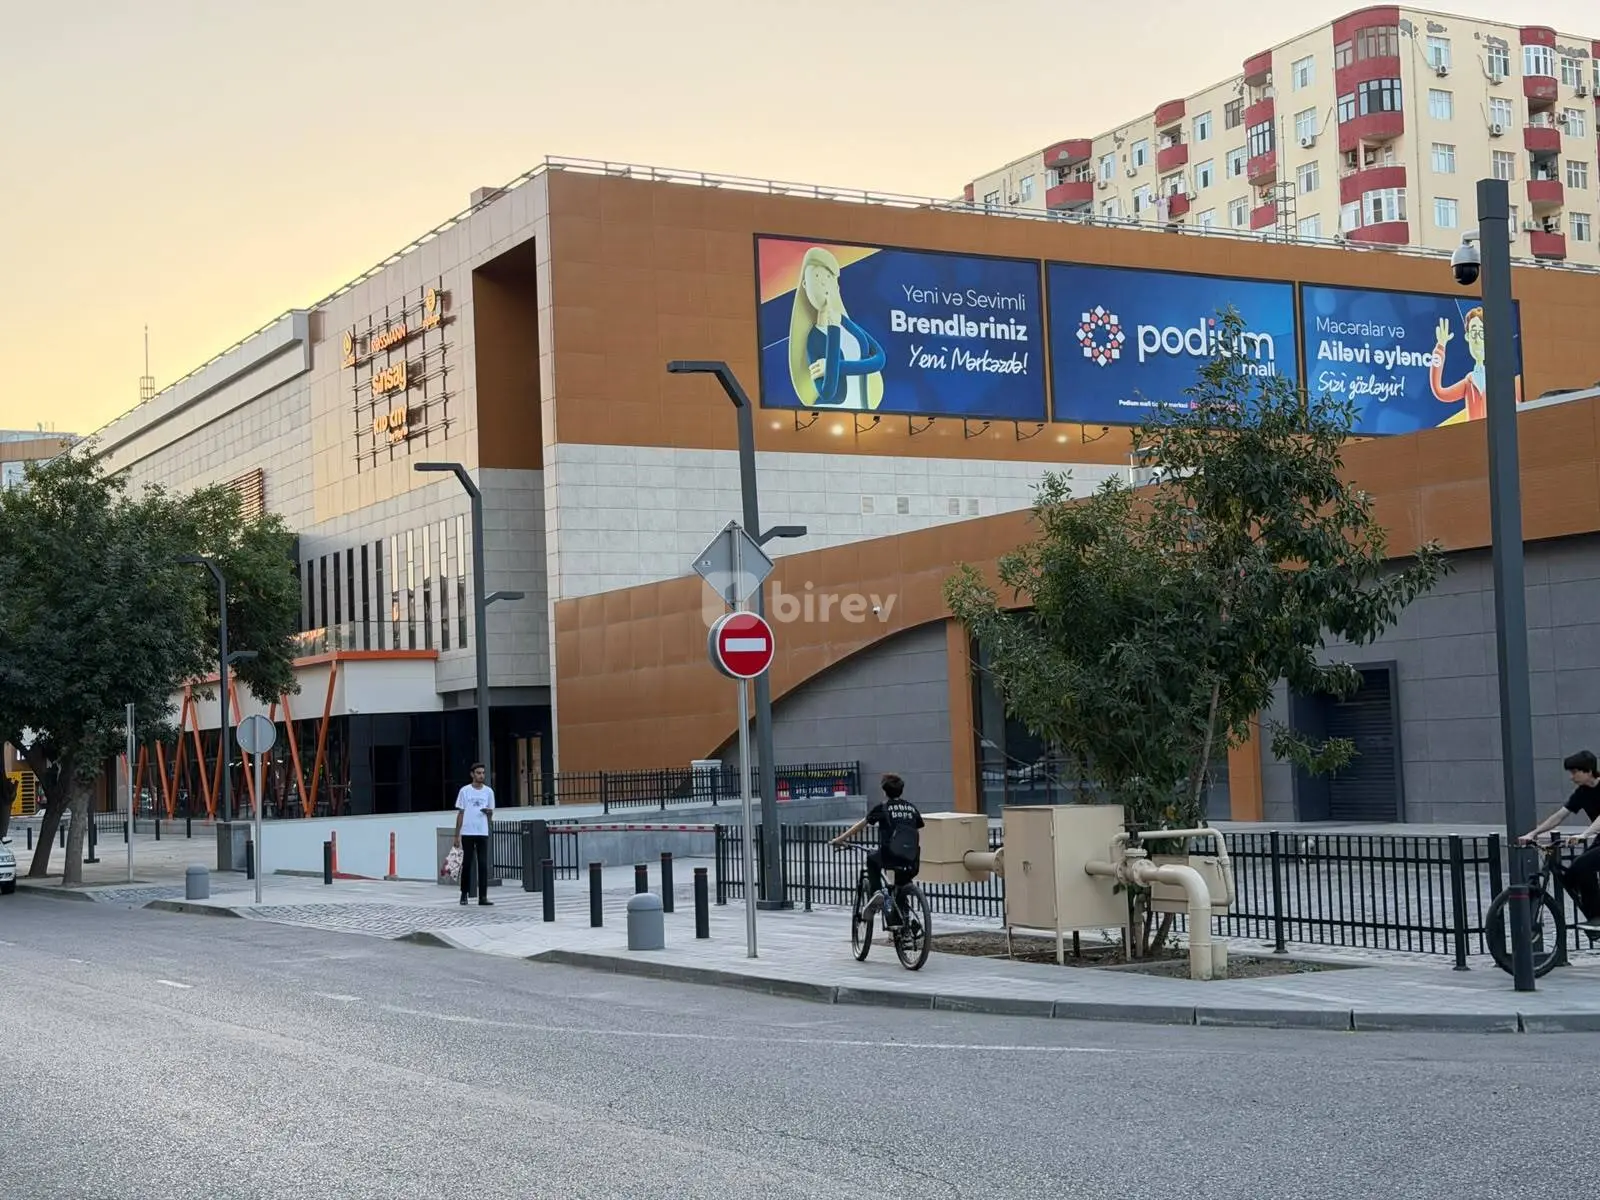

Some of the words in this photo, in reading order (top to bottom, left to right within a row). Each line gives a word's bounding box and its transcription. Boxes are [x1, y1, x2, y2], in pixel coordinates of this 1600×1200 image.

[902, 284, 939, 305] Yeni
[941, 290, 963, 306] və
[966, 289, 1026, 311] Sevimli
[890, 309, 1028, 341] Brendləriniz
[1316, 316, 1386, 339] Macəralar
[1388, 326, 1405, 339] və
[1137, 317, 1275, 363] podium
[909, 344, 949, 369] Yeni
[951, 346, 1029, 375] Mərkəzdə!
[1242, 361, 1275, 377] mall
[1317, 340, 1370, 364] Ailəvi
[1374, 345, 1443, 370] əyləncə
[1318, 371, 1347, 393] Sizi
